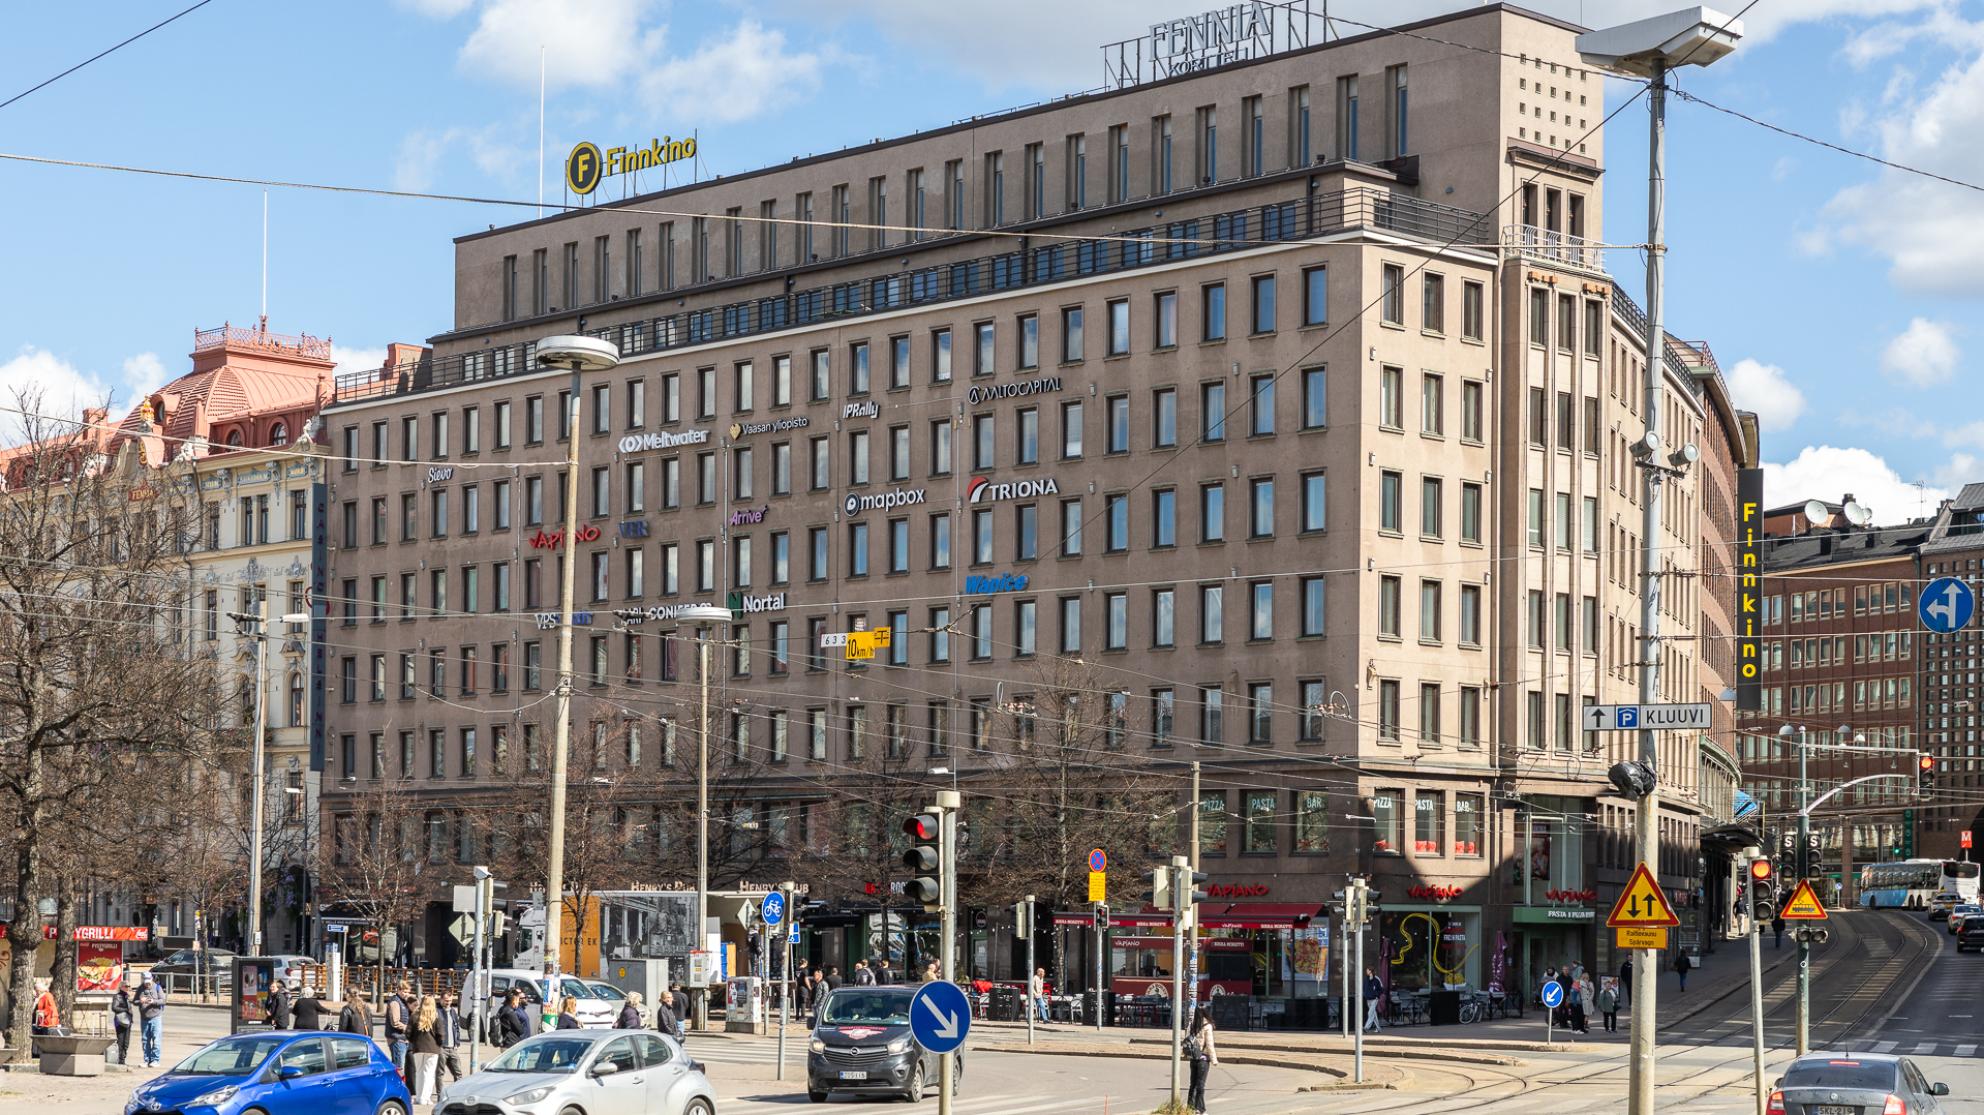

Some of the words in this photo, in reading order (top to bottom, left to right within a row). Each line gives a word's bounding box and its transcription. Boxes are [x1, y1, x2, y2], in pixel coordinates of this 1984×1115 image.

[1149, 1, 1271, 62] FENNIA
[606, 135, 697, 177] Finnkino
[842, 400, 879, 419] IPRally
[742, 423, 770, 436] Vaasan
[772, 416, 807, 433] yliopisto
[643, 429, 709, 451] Meltwater
[428, 467, 453, 484] Sievo
[990, 478, 1058, 501] TRIONA
[860, 487, 925, 511] mapbox
[731, 510, 763, 526] Arrive
[528, 523, 601, 550] VAPINO
[1742, 503, 1757, 678] Finnkino
[743, 592, 785, 613] Nortal
[534, 612, 556, 629] VPS
[1622, 713, 1632, 726] P
[1646, 709, 1703, 724] KLUUVI
[1203, 799, 1224, 811] PIZZA
[1251, 798, 1274, 810] PASTA
[1306, 798, 1321, 808] BAR
[1373, 797, 1392, 808] PIZZA
[1415, 799, 1433, 811] PASTA
[1457, 801, 1470, 812] BAR
[1204, 883, 1270, 898] VAPIANO
